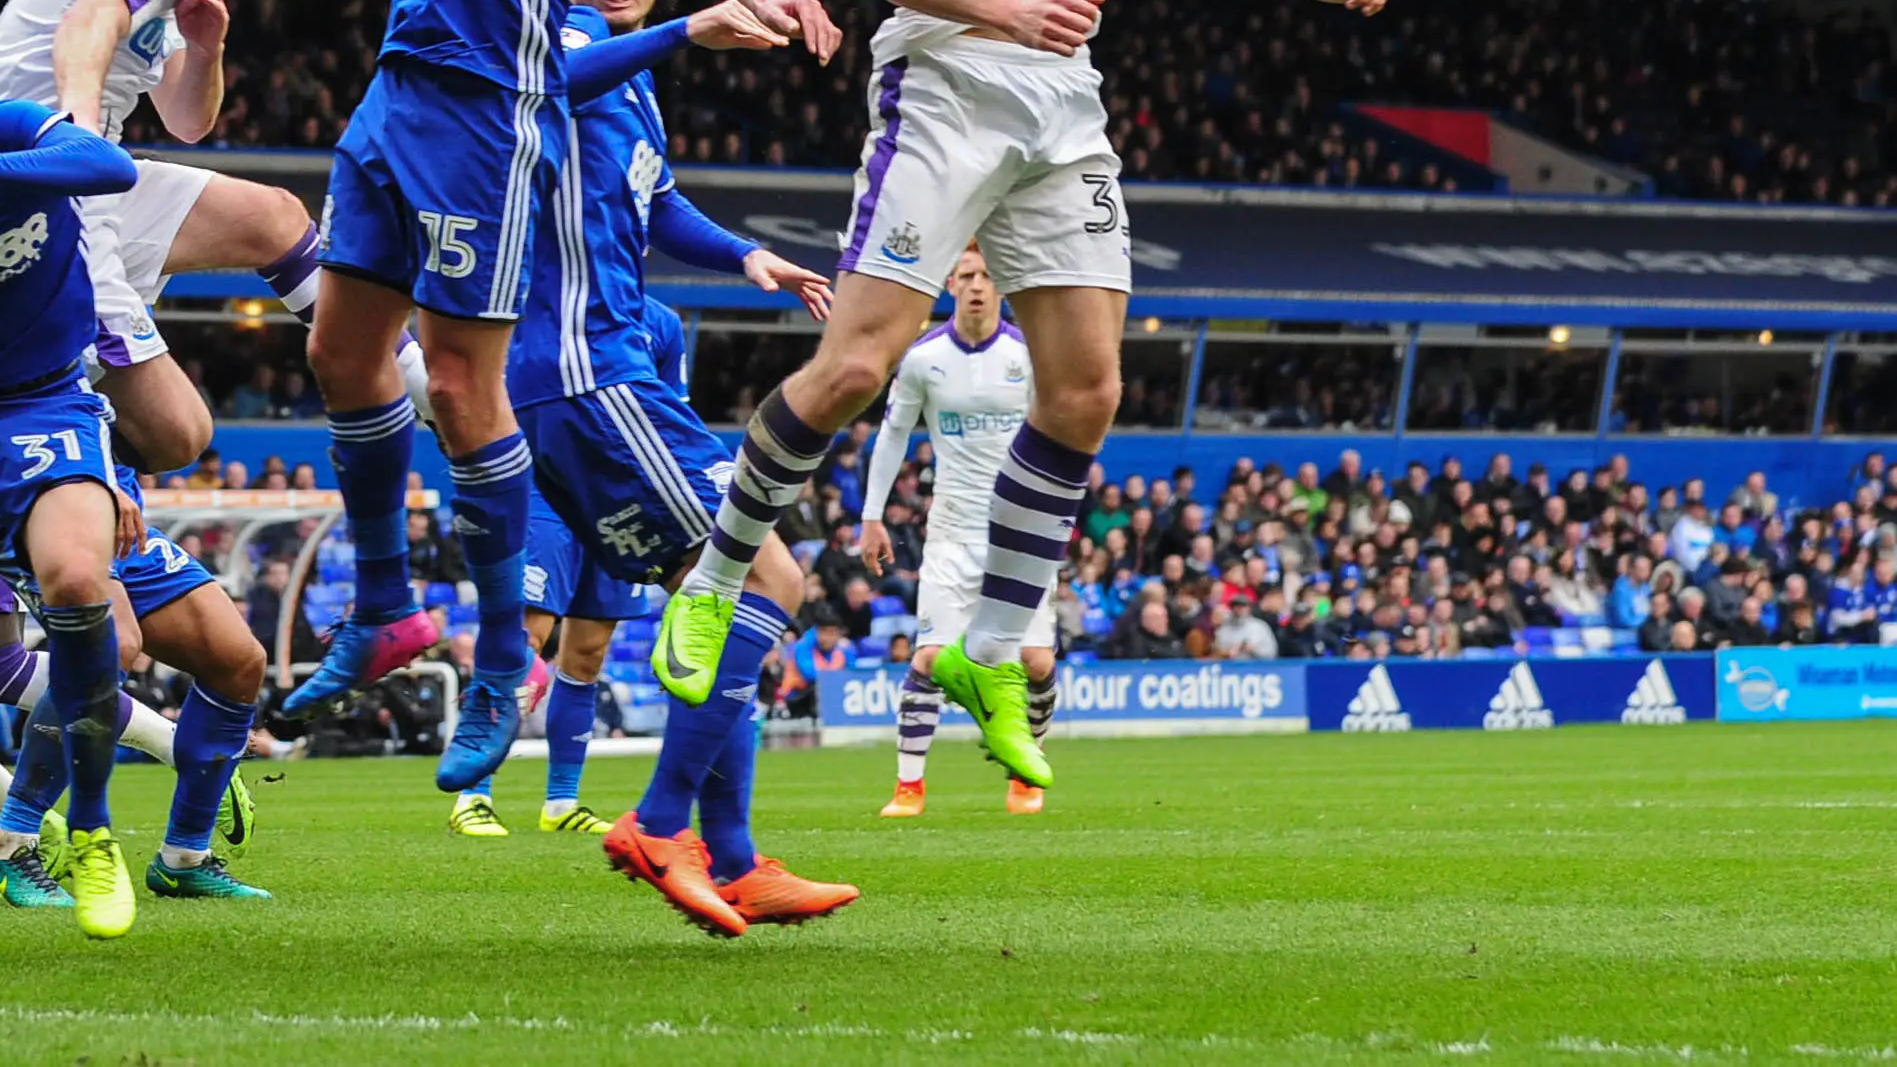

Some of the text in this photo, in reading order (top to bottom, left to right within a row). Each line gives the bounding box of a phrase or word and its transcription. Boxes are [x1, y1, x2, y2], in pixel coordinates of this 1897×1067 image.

[1082, 173, 1130, 236] 3
[419, 210, 478, 278] 15
[11, 429, 82, 480] 31
[1054, 663, 1283, 718] lour coatings
